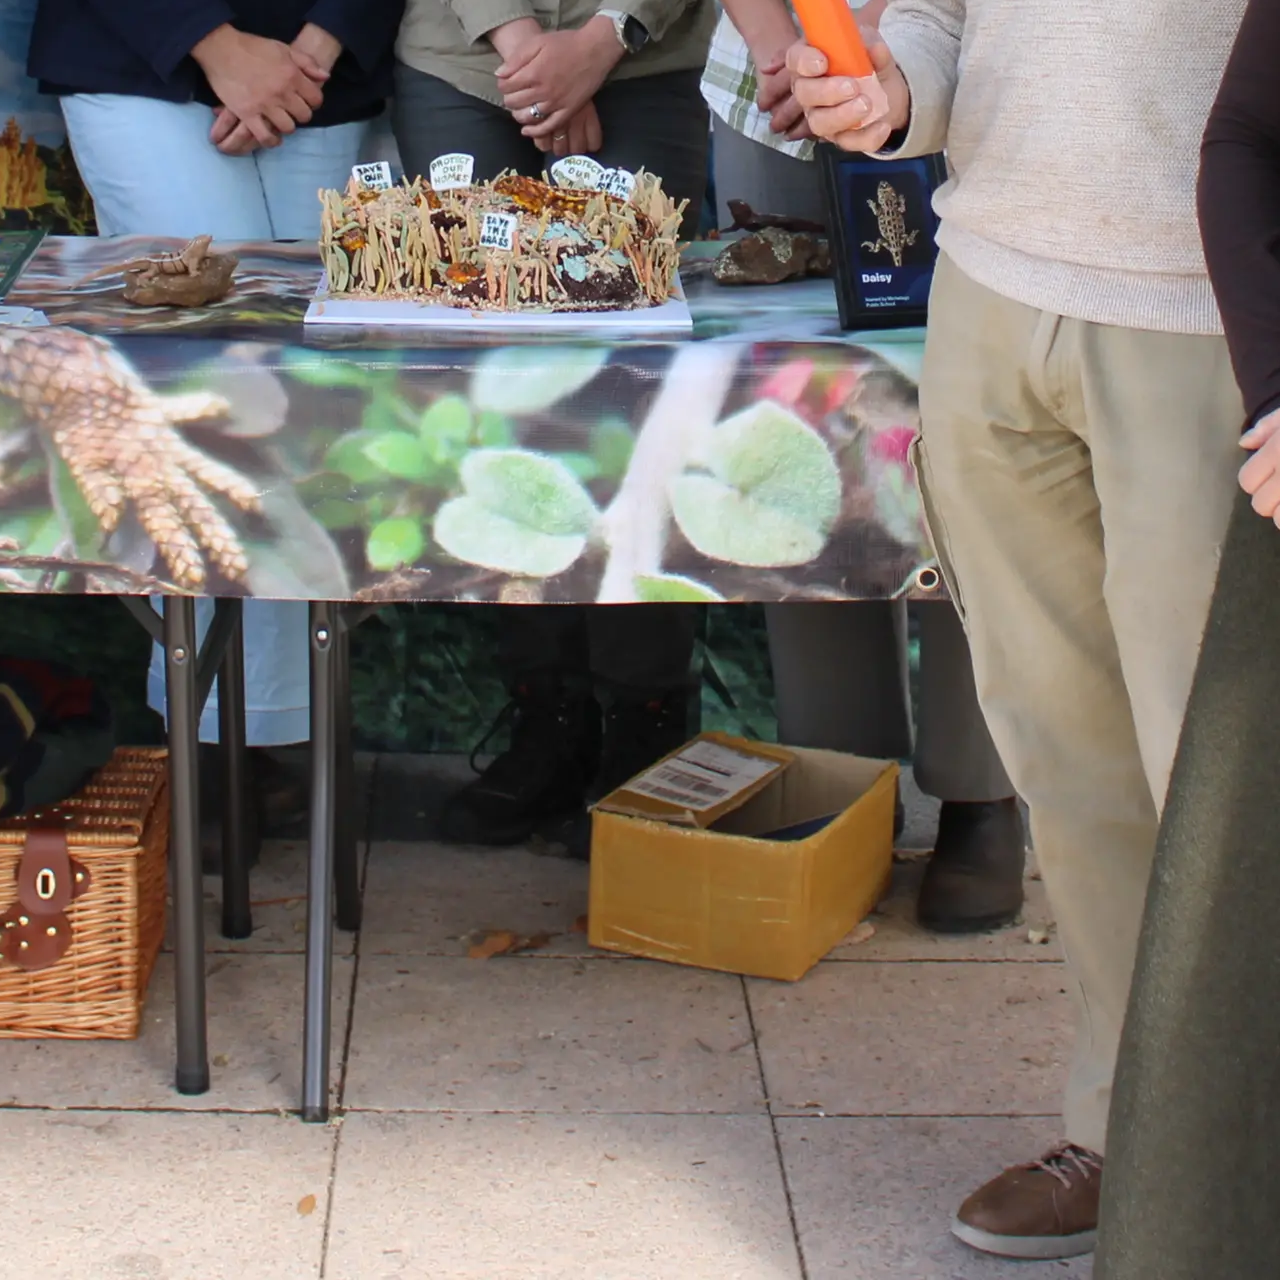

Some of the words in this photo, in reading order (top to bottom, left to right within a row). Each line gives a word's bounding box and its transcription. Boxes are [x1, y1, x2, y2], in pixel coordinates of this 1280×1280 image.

[357, 163, 382, 175] SAVE
[431, 157, 471, 172] PROTECT
[443, 165, 463, 173] OUR
[365, 173, 383, 182] OUR
[434, 174, 470, 184] HOMES
[568, 167, 590, 180] OUR
[487, 216, 509, 227] SAVE
[487, 226, 507, 237] THE
[481, 235, 508, 247] GRASS
[862, 272, 892, 284] Daisy
